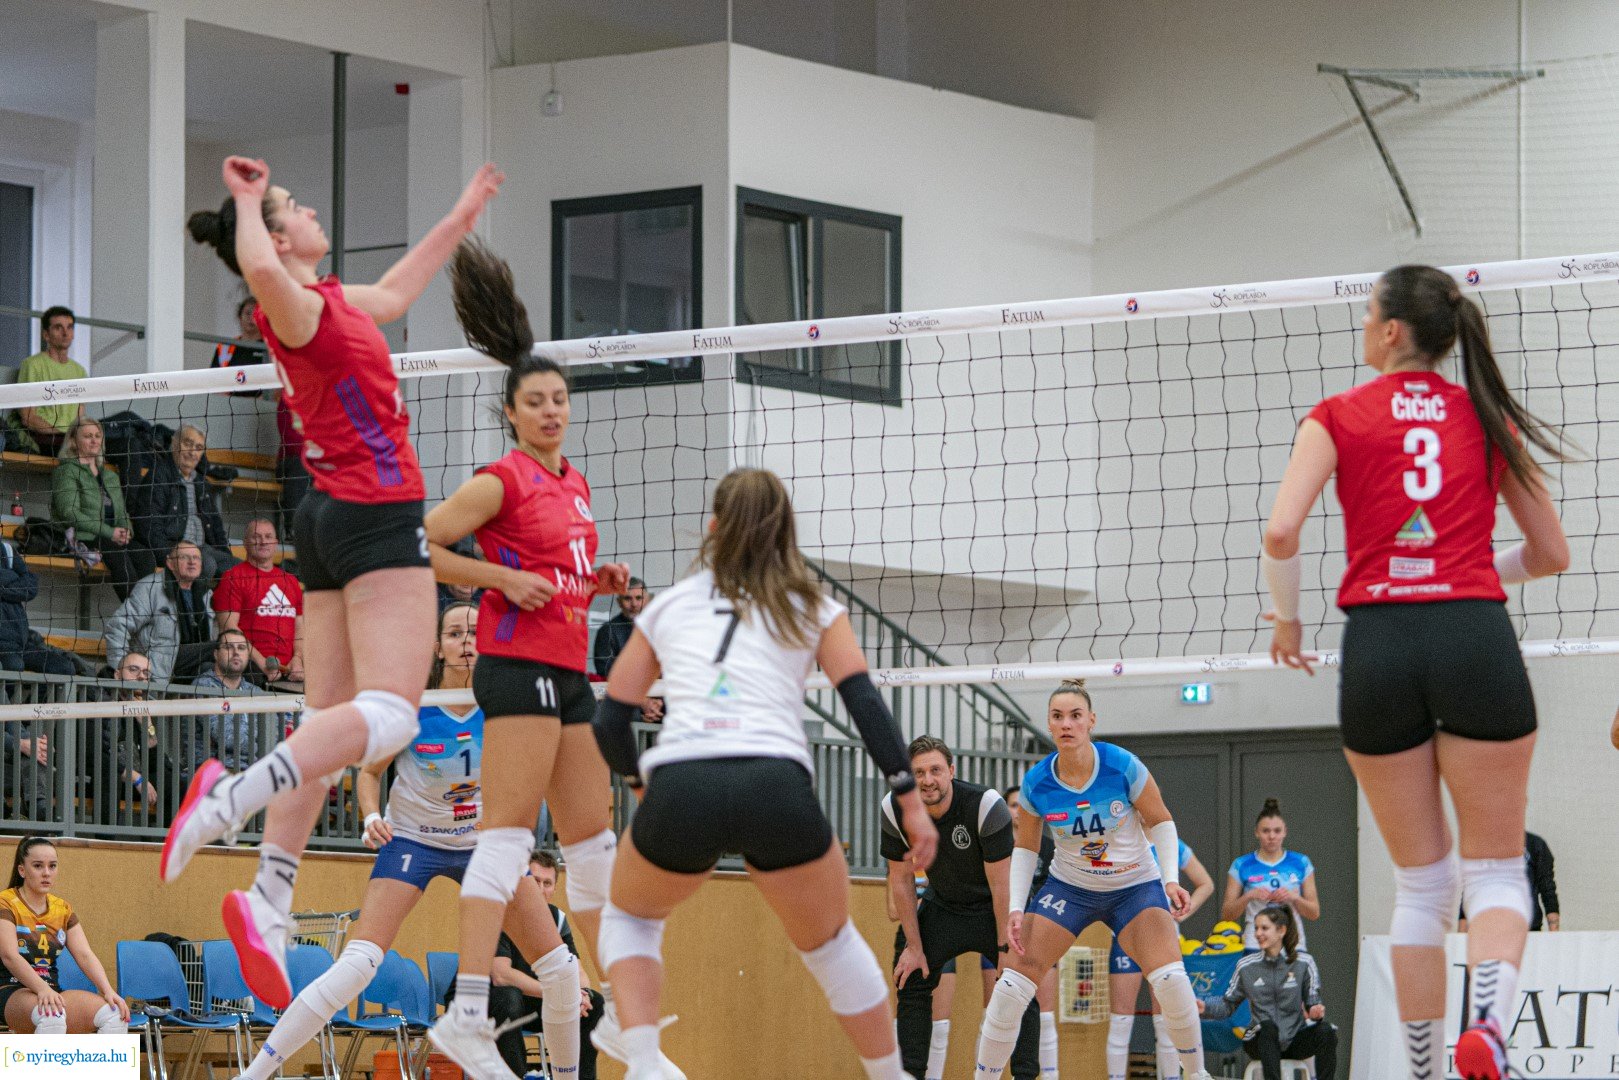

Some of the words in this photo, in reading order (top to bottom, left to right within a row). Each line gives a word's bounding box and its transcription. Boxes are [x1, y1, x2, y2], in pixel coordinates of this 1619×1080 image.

[1001, 308, 1044, 324] FATUM
[693, 335, 733, 349] FATUM
[400, 357, 438, 371] FATUM
[133, 378, 169, 392] FATUM
[1402, 427, 1443, 501] 3
[569, 537, 593, 576] 11
[257, 605, 296, 618] adidas
[714, 608, 740, 664] 7
[991, 667, 1025, 680] FATUM
[536, 676, 556, 708] 11
[122, 704, 150, 716] FATUM
[460, 749, 471, 777] 1
[1072, 813, 1106, 839] 44
[402, 853, 413, 872] 1
[1270, 878, 1281, 892] 9
[1039, 893, 1067, 916] 44
[38, 933, 50, 955] 4
[1116, 956, 1131, 970] 15
